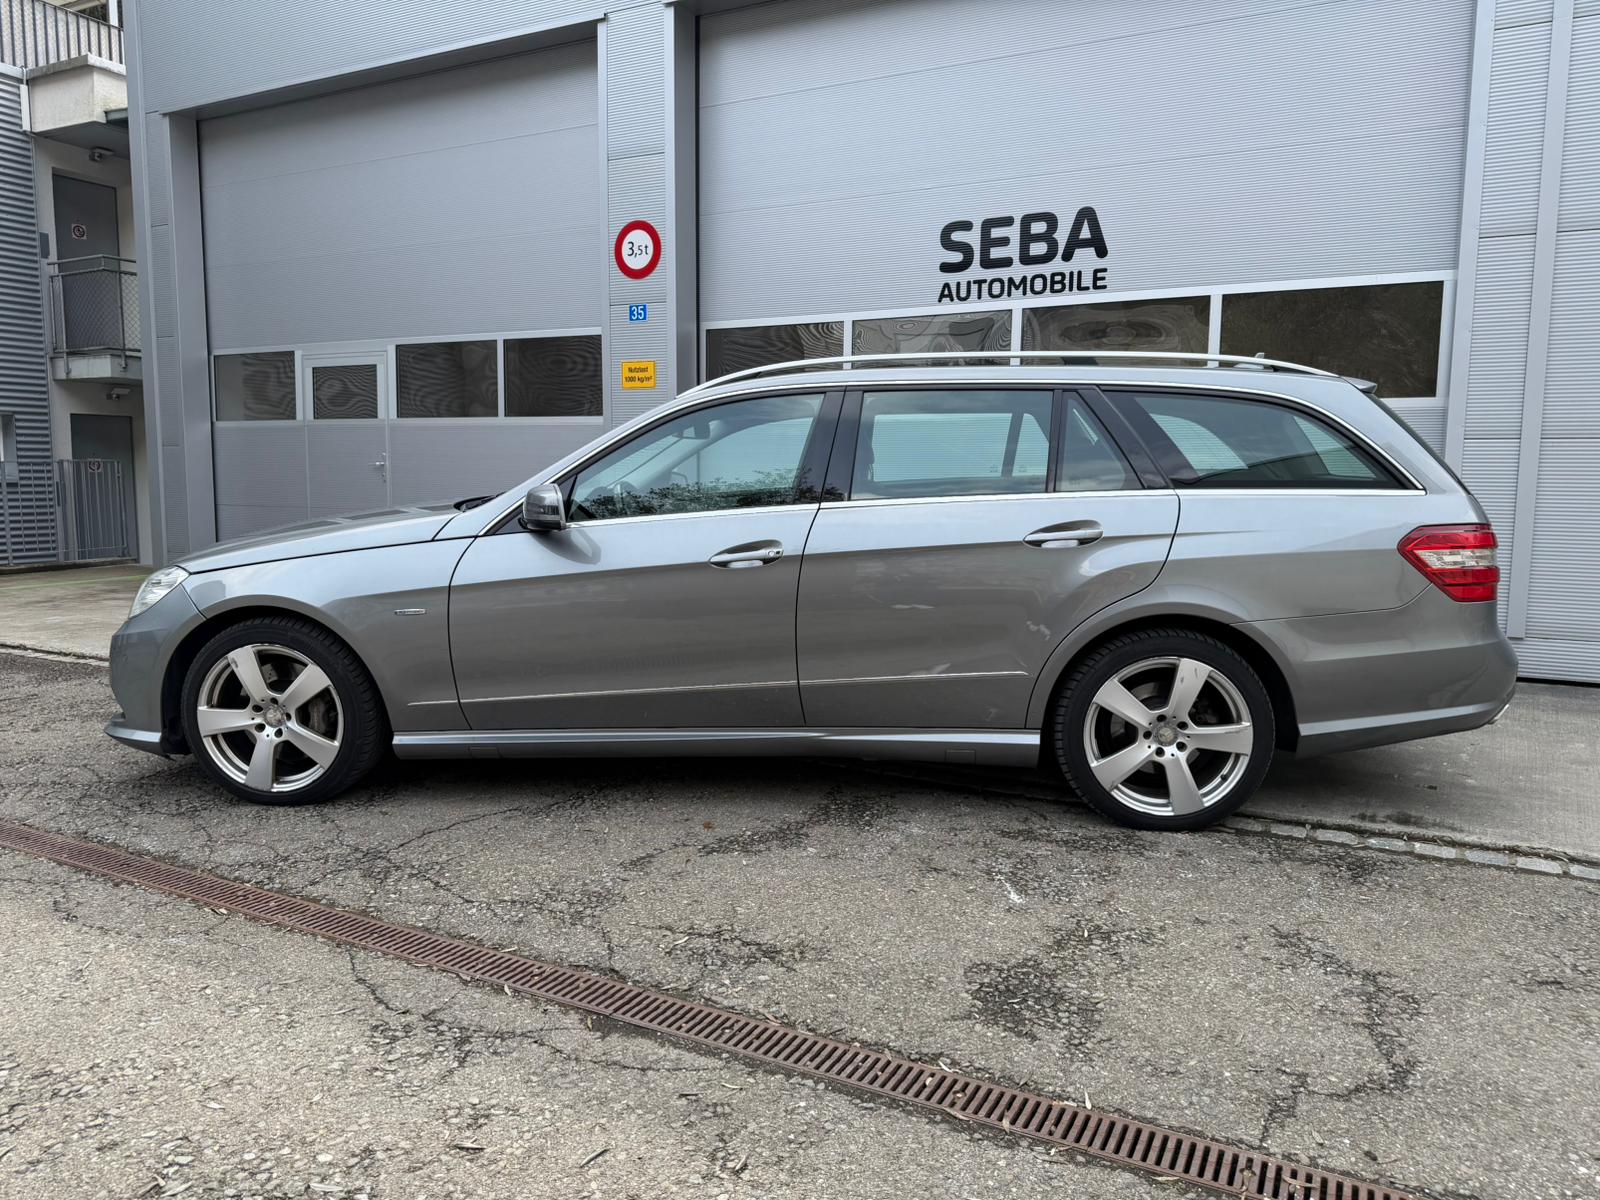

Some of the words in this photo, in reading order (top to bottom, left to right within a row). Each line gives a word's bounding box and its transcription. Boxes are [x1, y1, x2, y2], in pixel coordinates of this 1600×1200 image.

[939, 206, 1108, 273] SEBA
[937, 267, 1108, 303] AUTOMOBILE
[631, 306, 644, 320] 35
[624, 375, 637, 383] 1000
